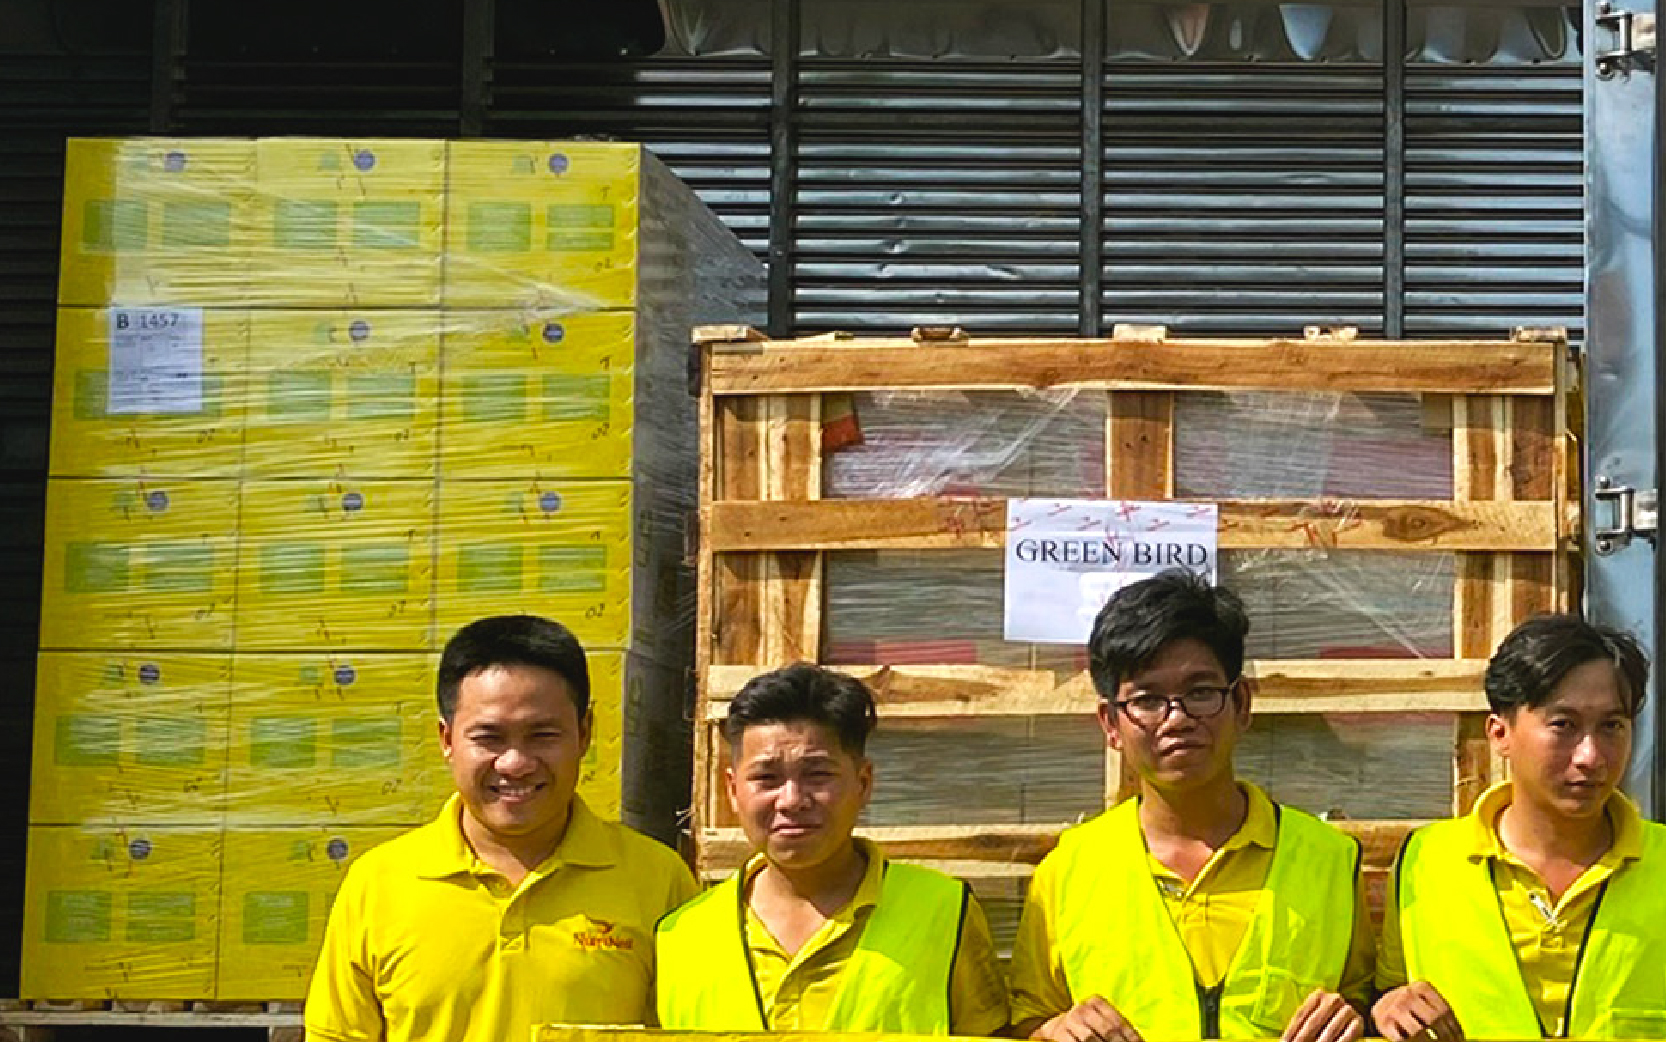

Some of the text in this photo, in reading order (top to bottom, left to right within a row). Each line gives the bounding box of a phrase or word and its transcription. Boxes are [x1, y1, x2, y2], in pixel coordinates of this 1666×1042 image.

[116, 313, 129, 330] B
[1016, 539, 1208, 566] GREEN BIRD
